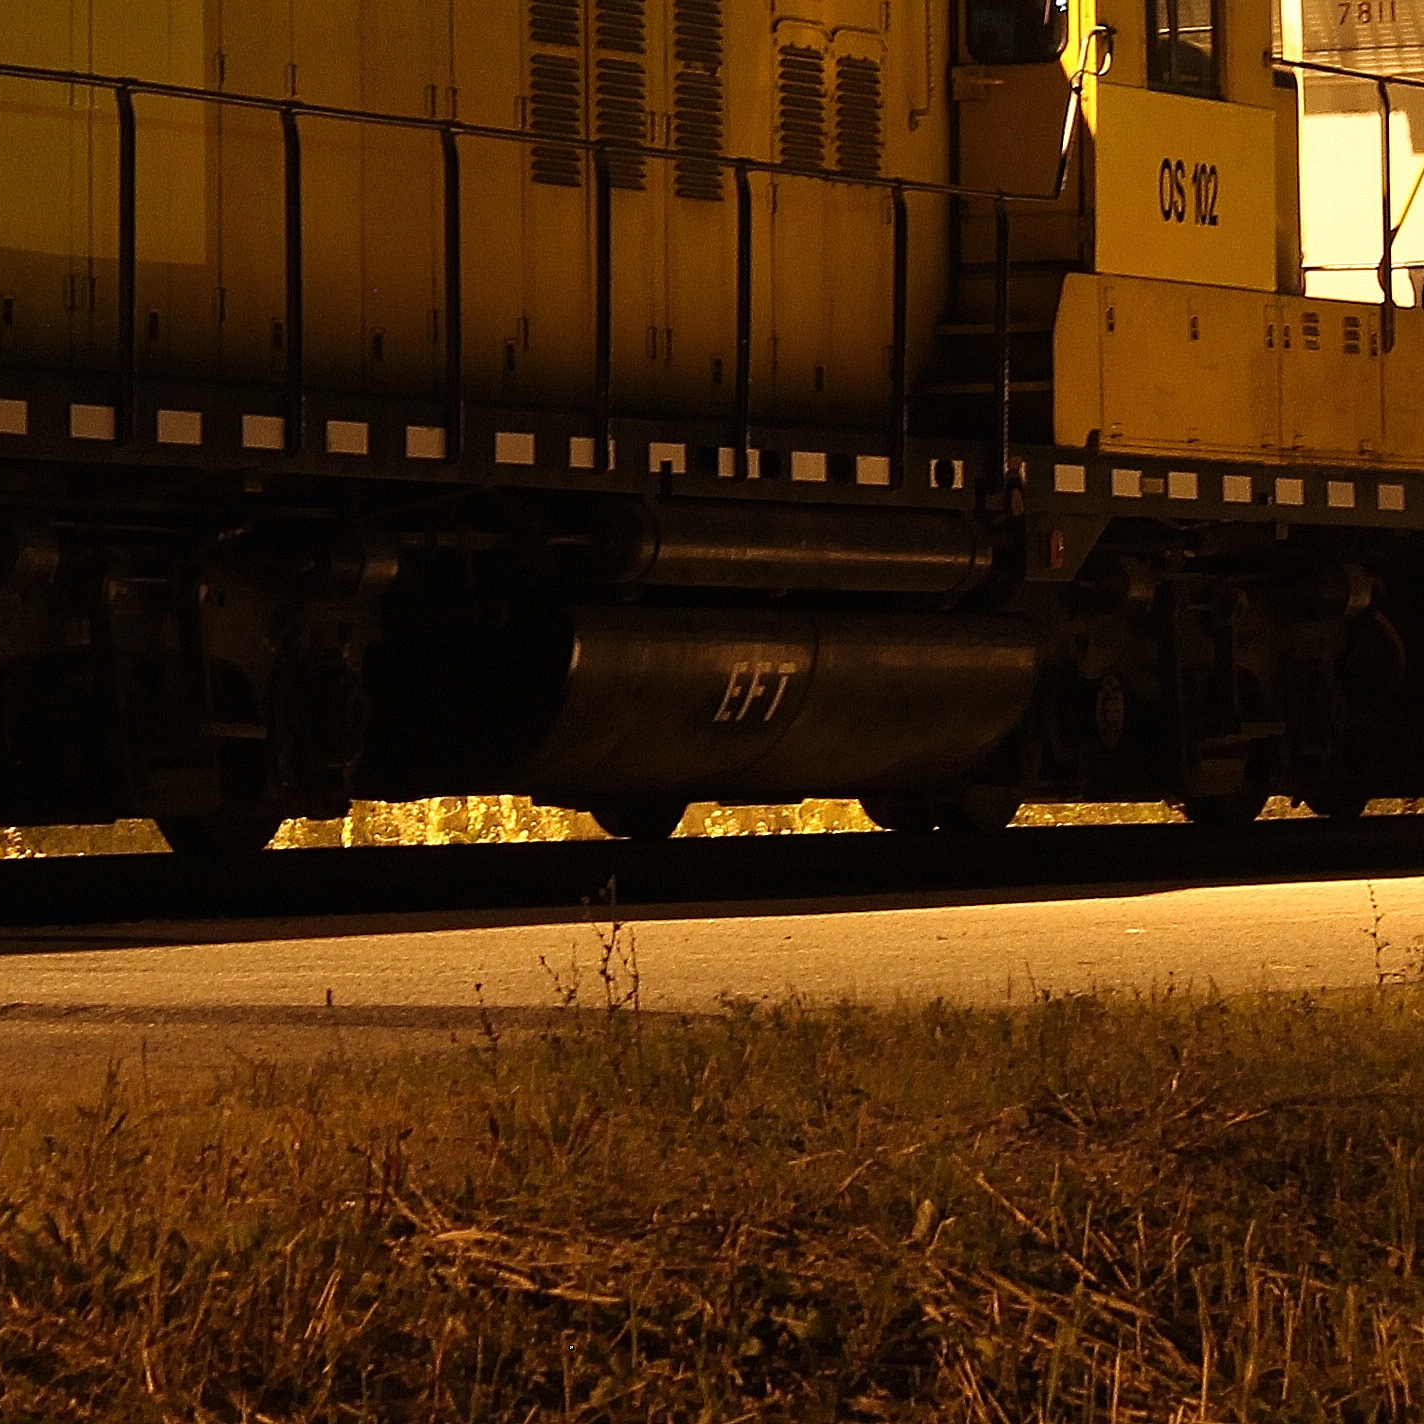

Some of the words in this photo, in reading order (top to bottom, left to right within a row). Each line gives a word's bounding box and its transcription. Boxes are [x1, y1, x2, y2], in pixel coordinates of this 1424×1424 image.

[1337, 0, 1398, 26] 7811
[1159, 157, 1186, 223] OS
[1192, 163, 1219, 227] 102
[713, 661, 796, 724] EFT
